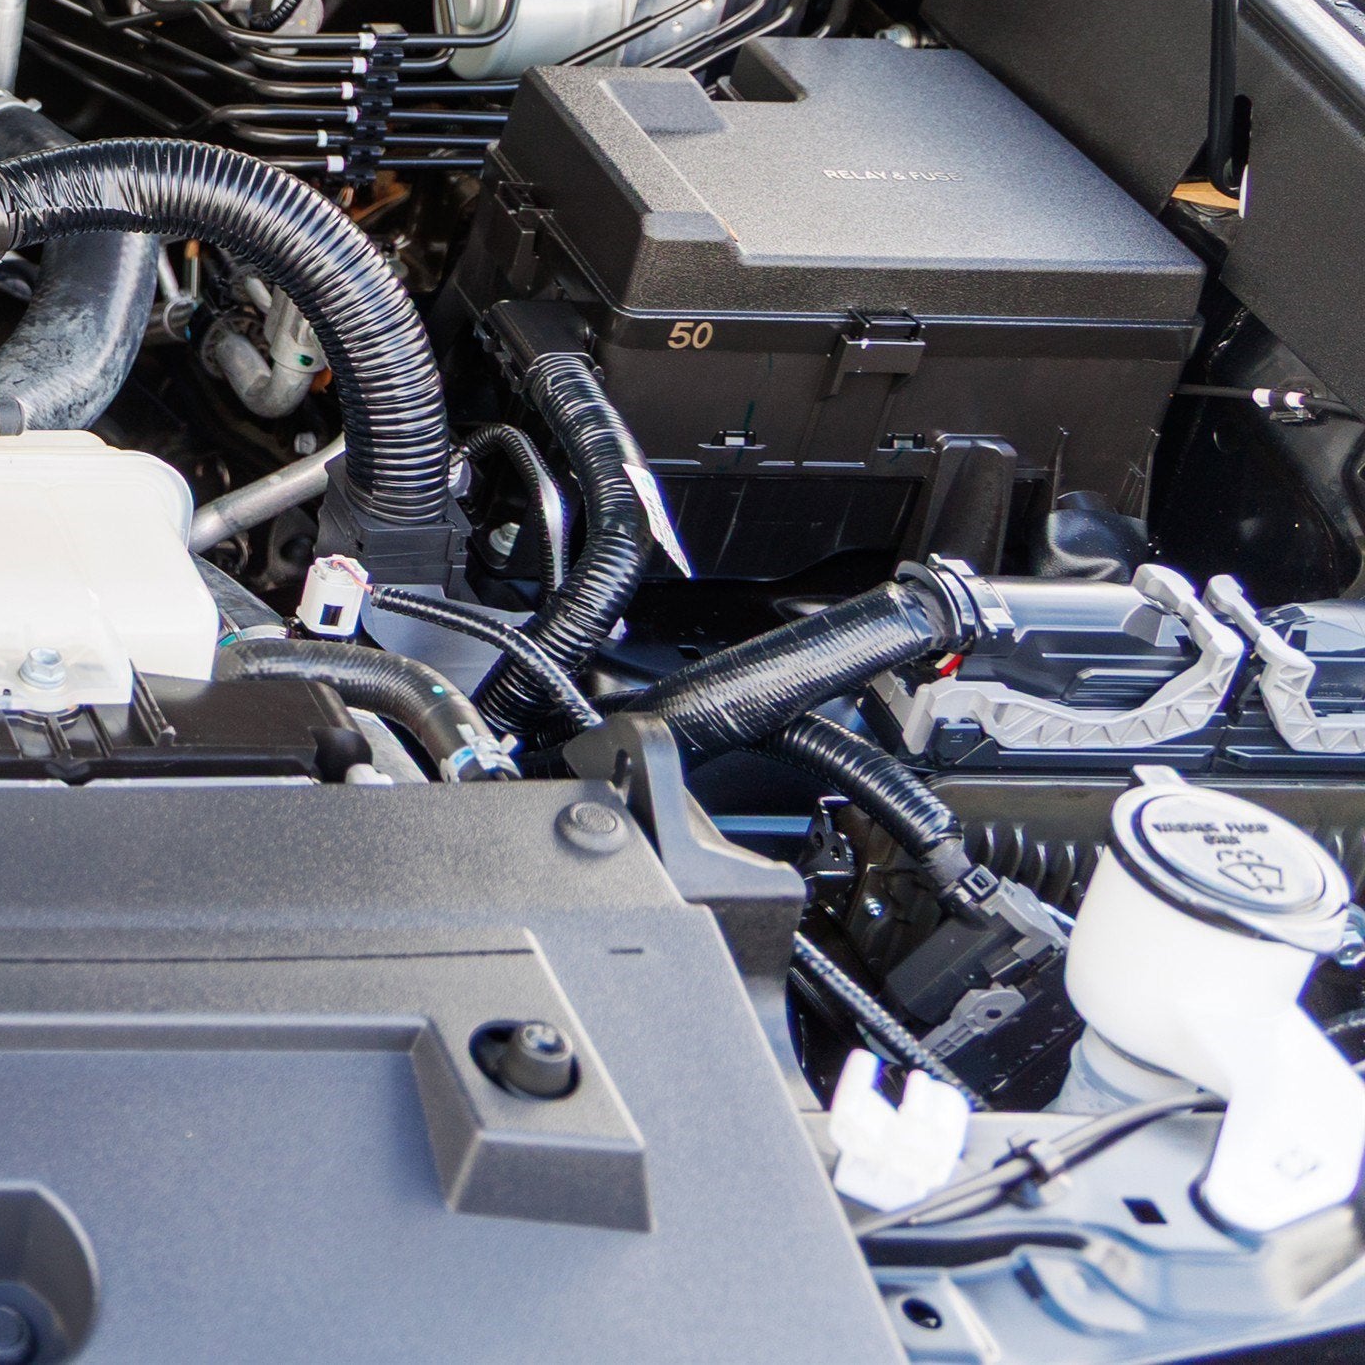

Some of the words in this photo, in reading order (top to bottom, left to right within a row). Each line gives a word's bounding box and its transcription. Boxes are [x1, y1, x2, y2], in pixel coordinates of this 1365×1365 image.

[823, 168, 888, 182] RELAY
[891, 169, 906, 182] &
[909, 169, 963, 182] FUSE
[667, 322, 714, 350] 50
